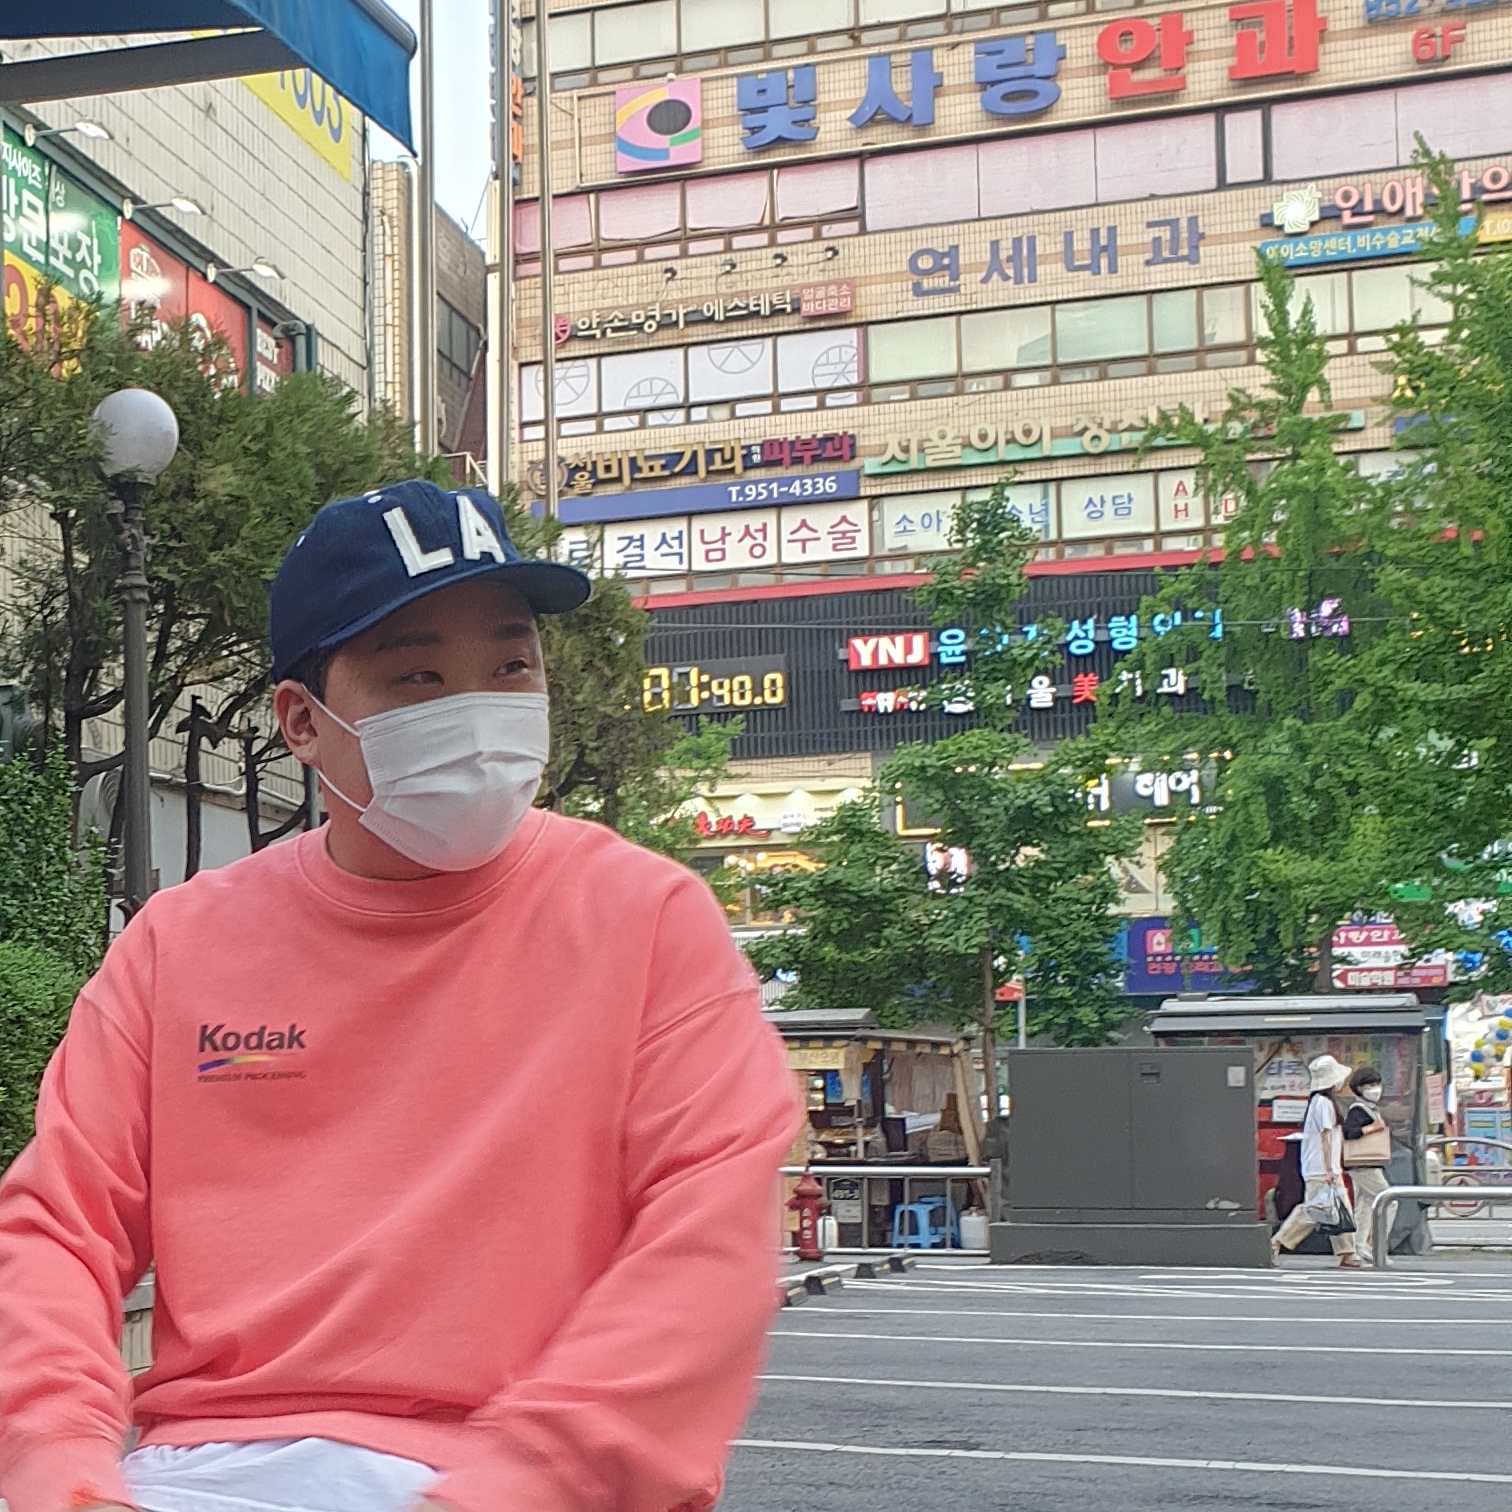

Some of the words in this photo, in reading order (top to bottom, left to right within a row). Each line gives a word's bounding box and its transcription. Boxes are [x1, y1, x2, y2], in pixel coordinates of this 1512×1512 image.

[1412, 22, 1466, 61] 6F
[907, 216, 1206, 297] 연세내과
[576, 303, 697, 339] 약손명가
[702, 290, 793, 321] 에스테틱
[595, 440, 747, 490] 비뇨기과
[761, 431, 855, 469] 피부과
[880, 416, 1053, 470] 서울아이
[727, 476, 838, 504] T.951-4336
[894, 509, 943, 534] 소아
[1082, 493, 1134, 521] 상담
[616, 528, 685, 570] 결석
[698, 521, 769, 565] 남성
[786, 513, 863, 555] 수술
[850, 635, 926, 667] YNJ
[198, 1022, 307, 1053] Kodak
